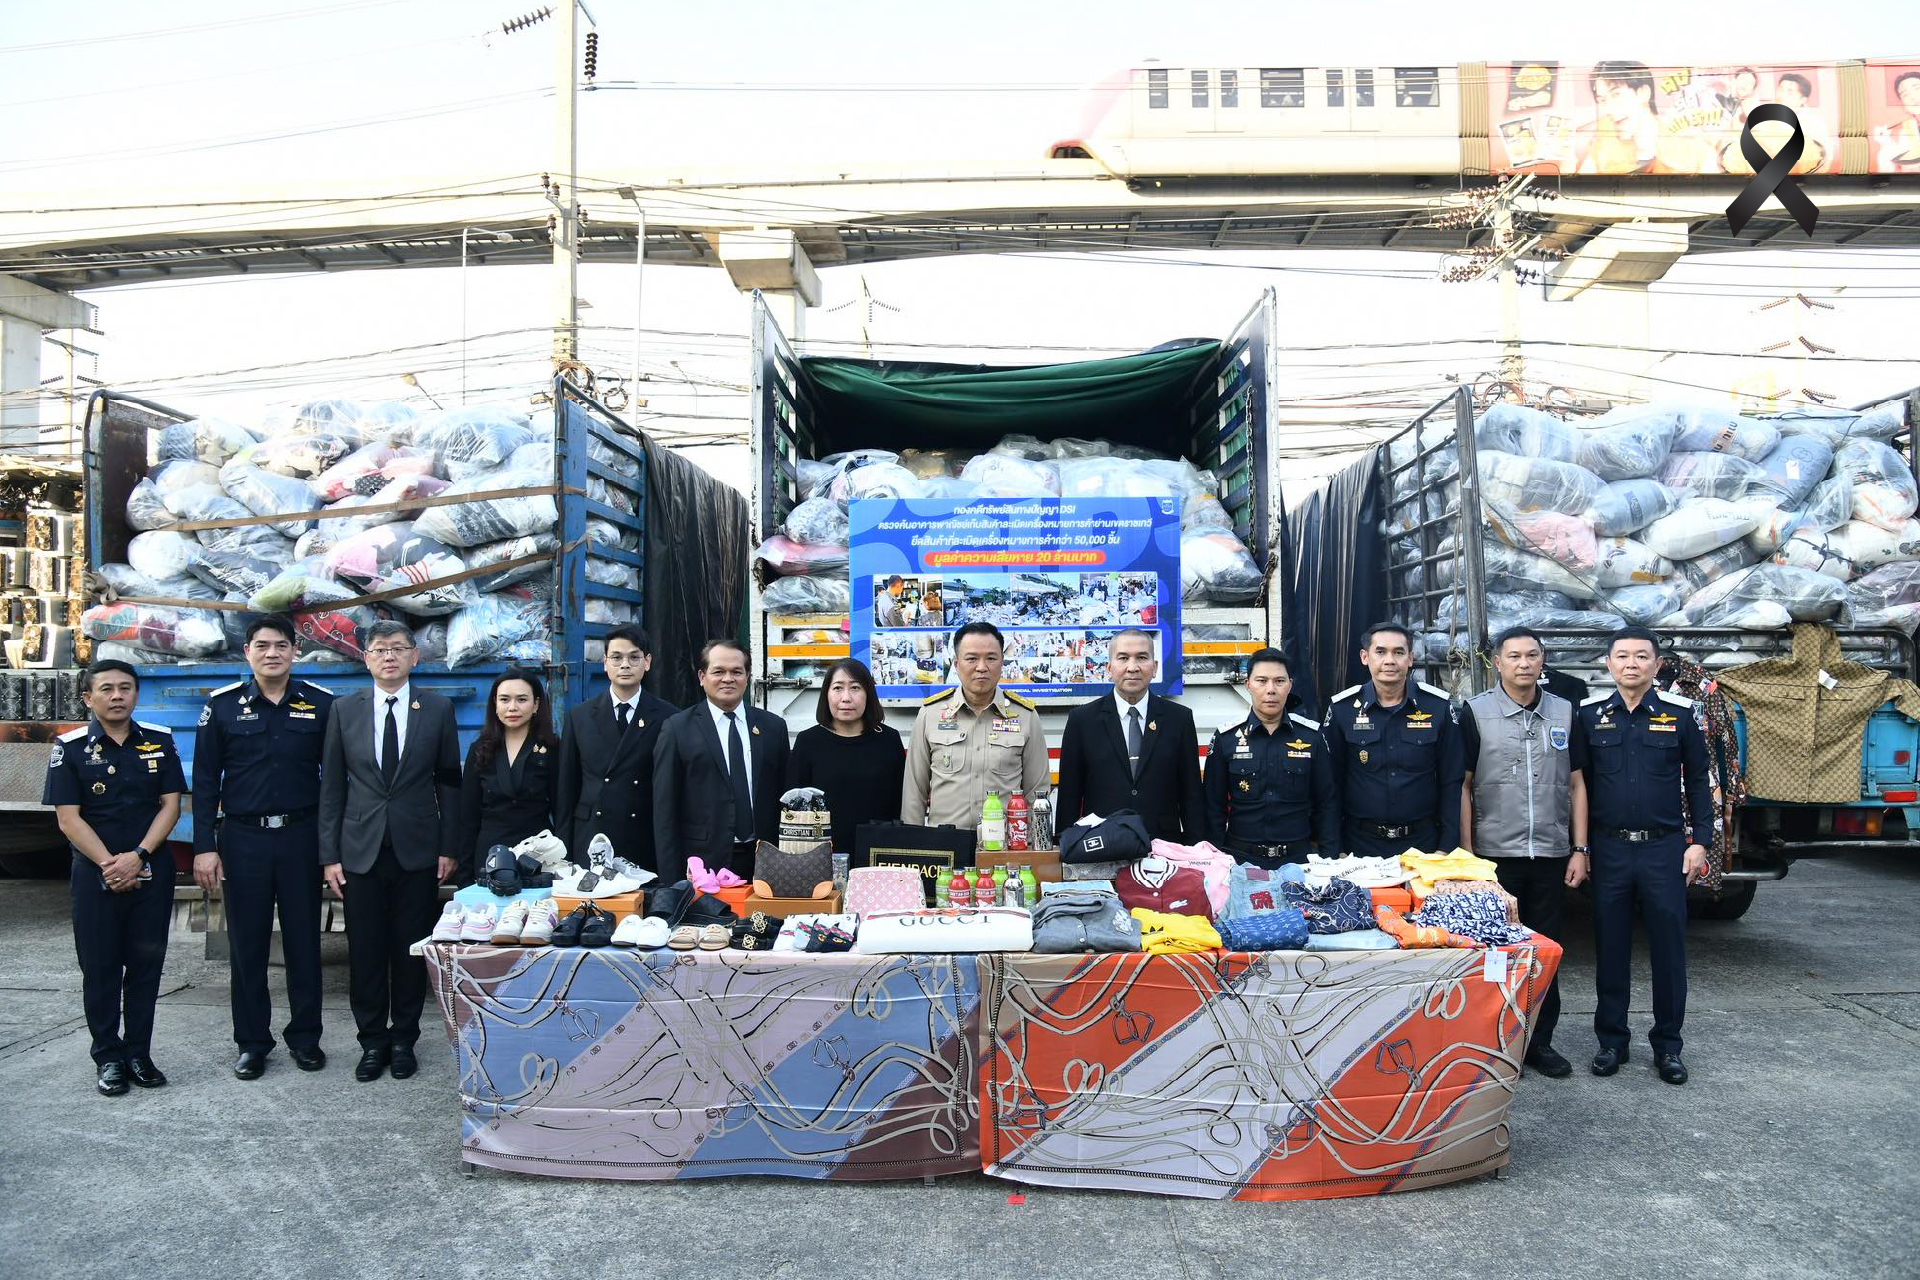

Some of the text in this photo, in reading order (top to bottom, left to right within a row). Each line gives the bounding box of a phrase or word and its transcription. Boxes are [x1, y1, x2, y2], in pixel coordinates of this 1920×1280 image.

[1060, 505, 1076, 514] DSI
[1074, 535, 1105, 546] 50,000
[1107, 531, 1120, 545] ชิ้น
[934, 549, 1098, 568] มูลค่าความเสียหาย 20 ล้านบาท
